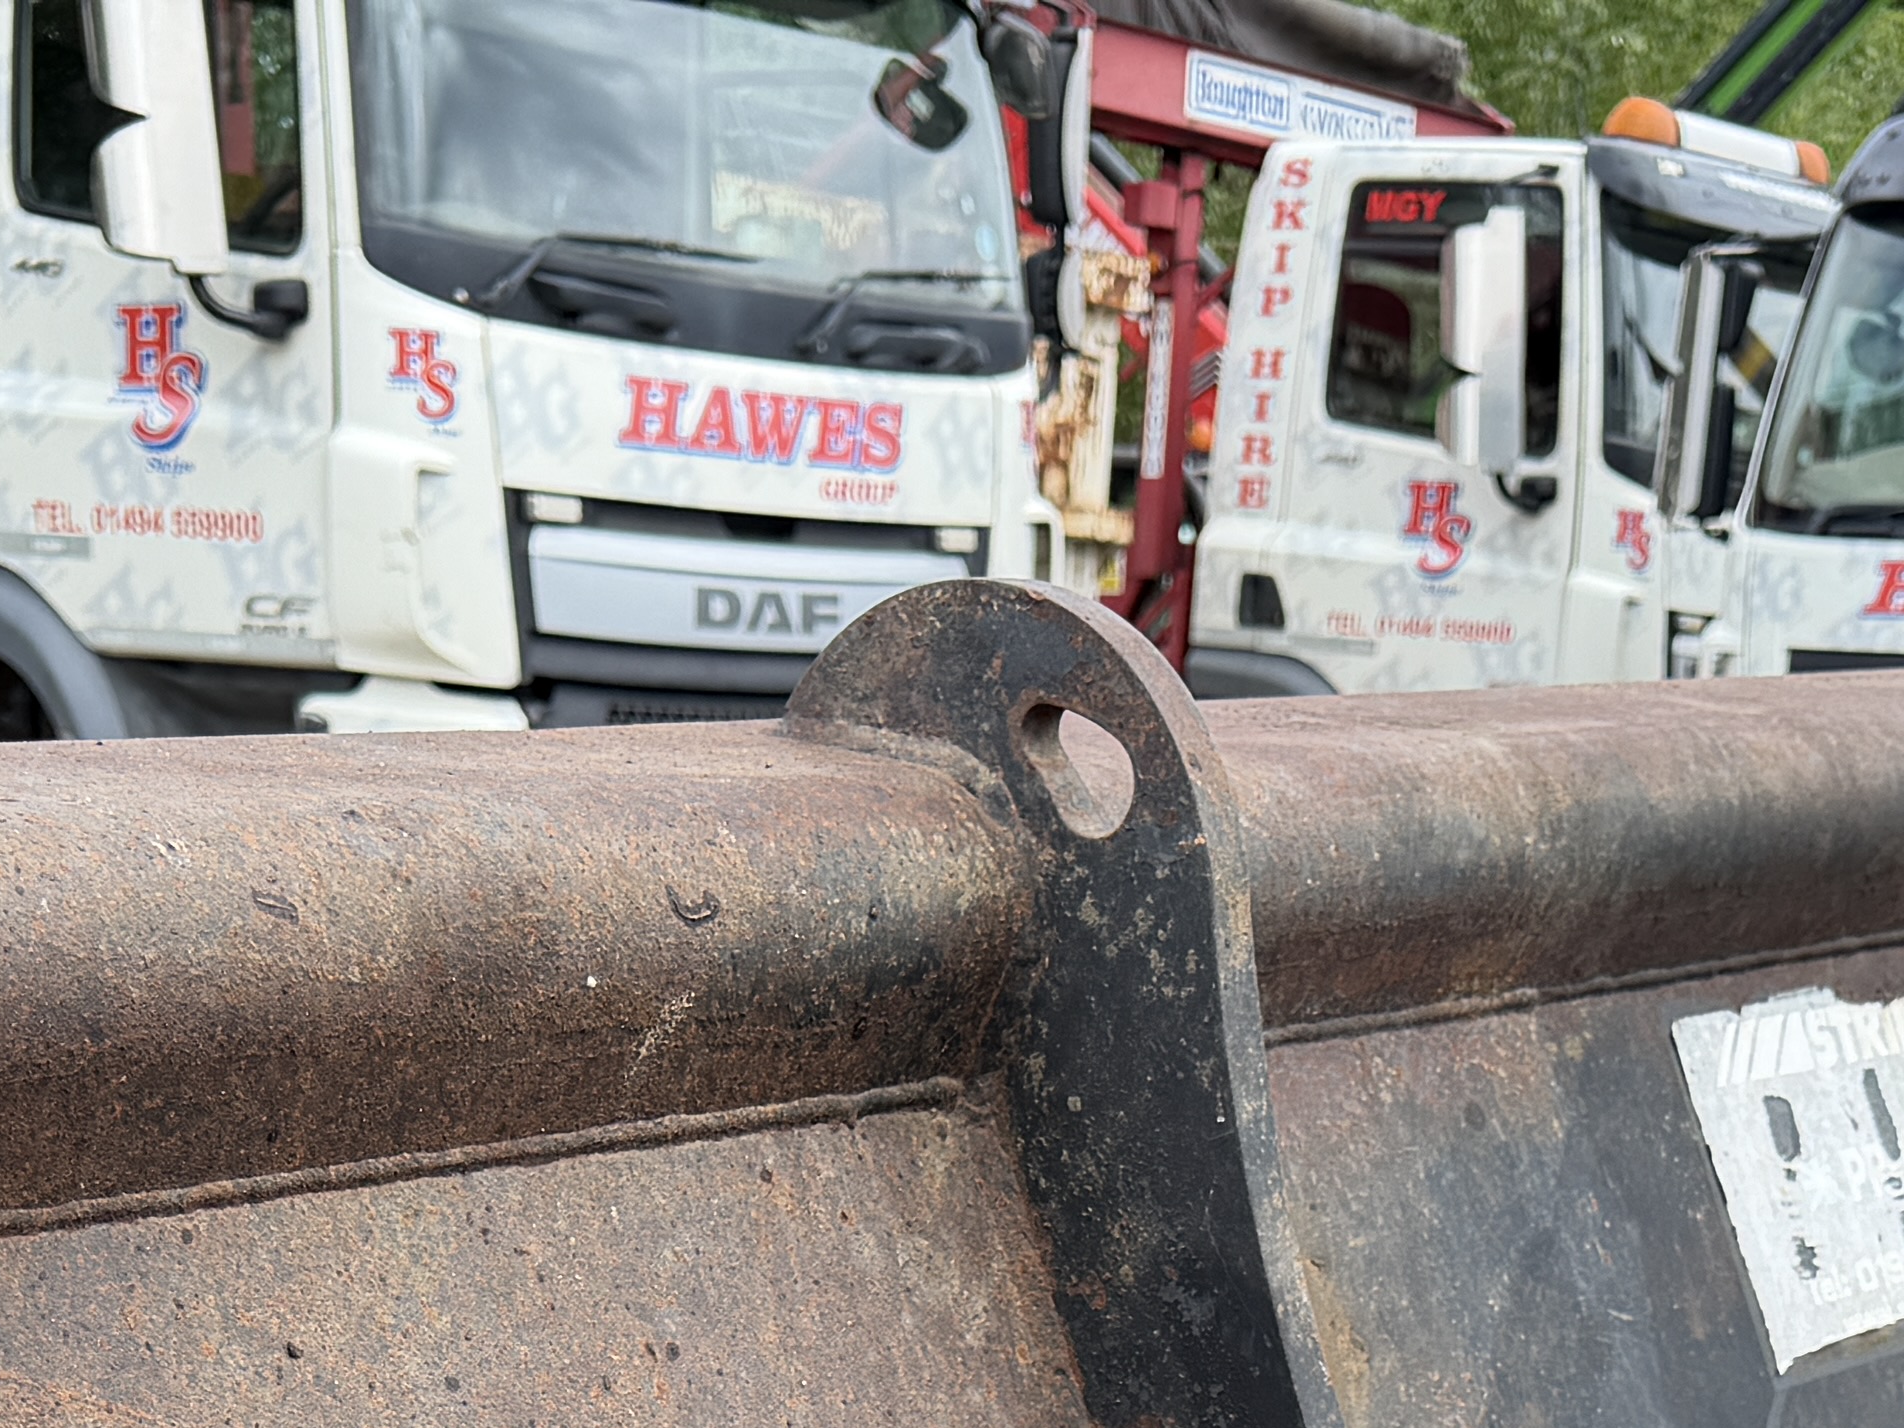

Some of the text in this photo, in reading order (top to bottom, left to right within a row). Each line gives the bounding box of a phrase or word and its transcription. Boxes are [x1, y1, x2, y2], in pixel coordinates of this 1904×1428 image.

[1238, 157, 1313, 509] SKIP HIRE
[618, 374, 907, 474] HAWES
[695, 586, 841, 637] DAF
